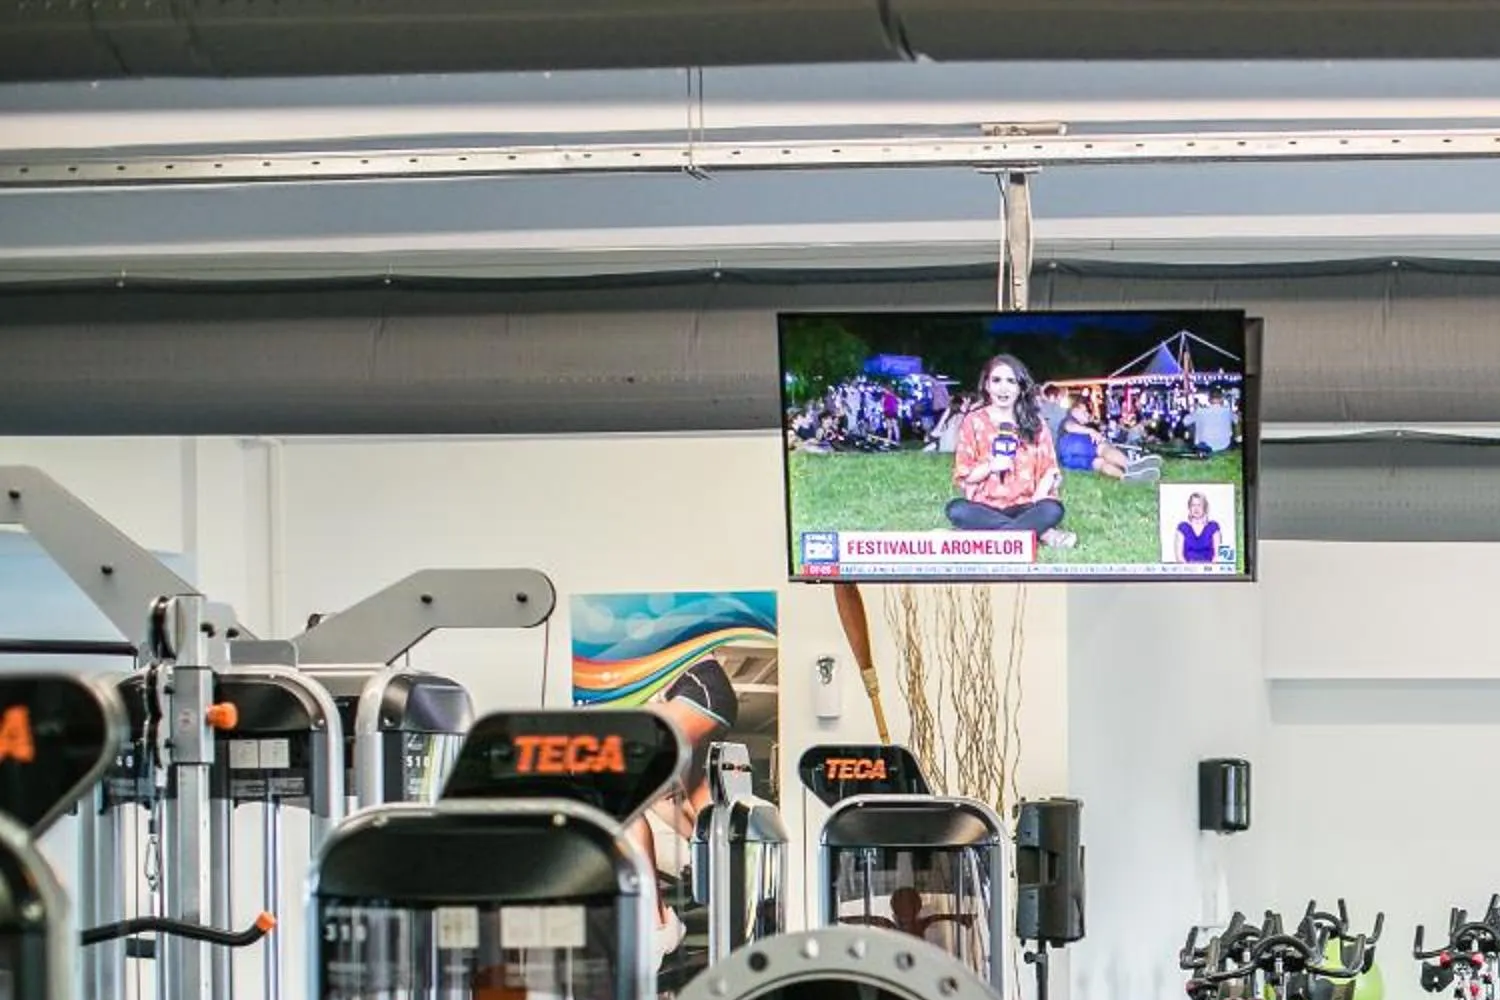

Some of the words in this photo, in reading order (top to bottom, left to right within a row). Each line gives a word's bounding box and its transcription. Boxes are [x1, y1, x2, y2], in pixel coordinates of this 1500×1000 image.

[847, 540, 937, 555] FESTIVALUL
[941, 540, 1023, 555] AROMELOR
[514, 735, 625, 773] TECA
[825, 758, 887, 779] TECA
